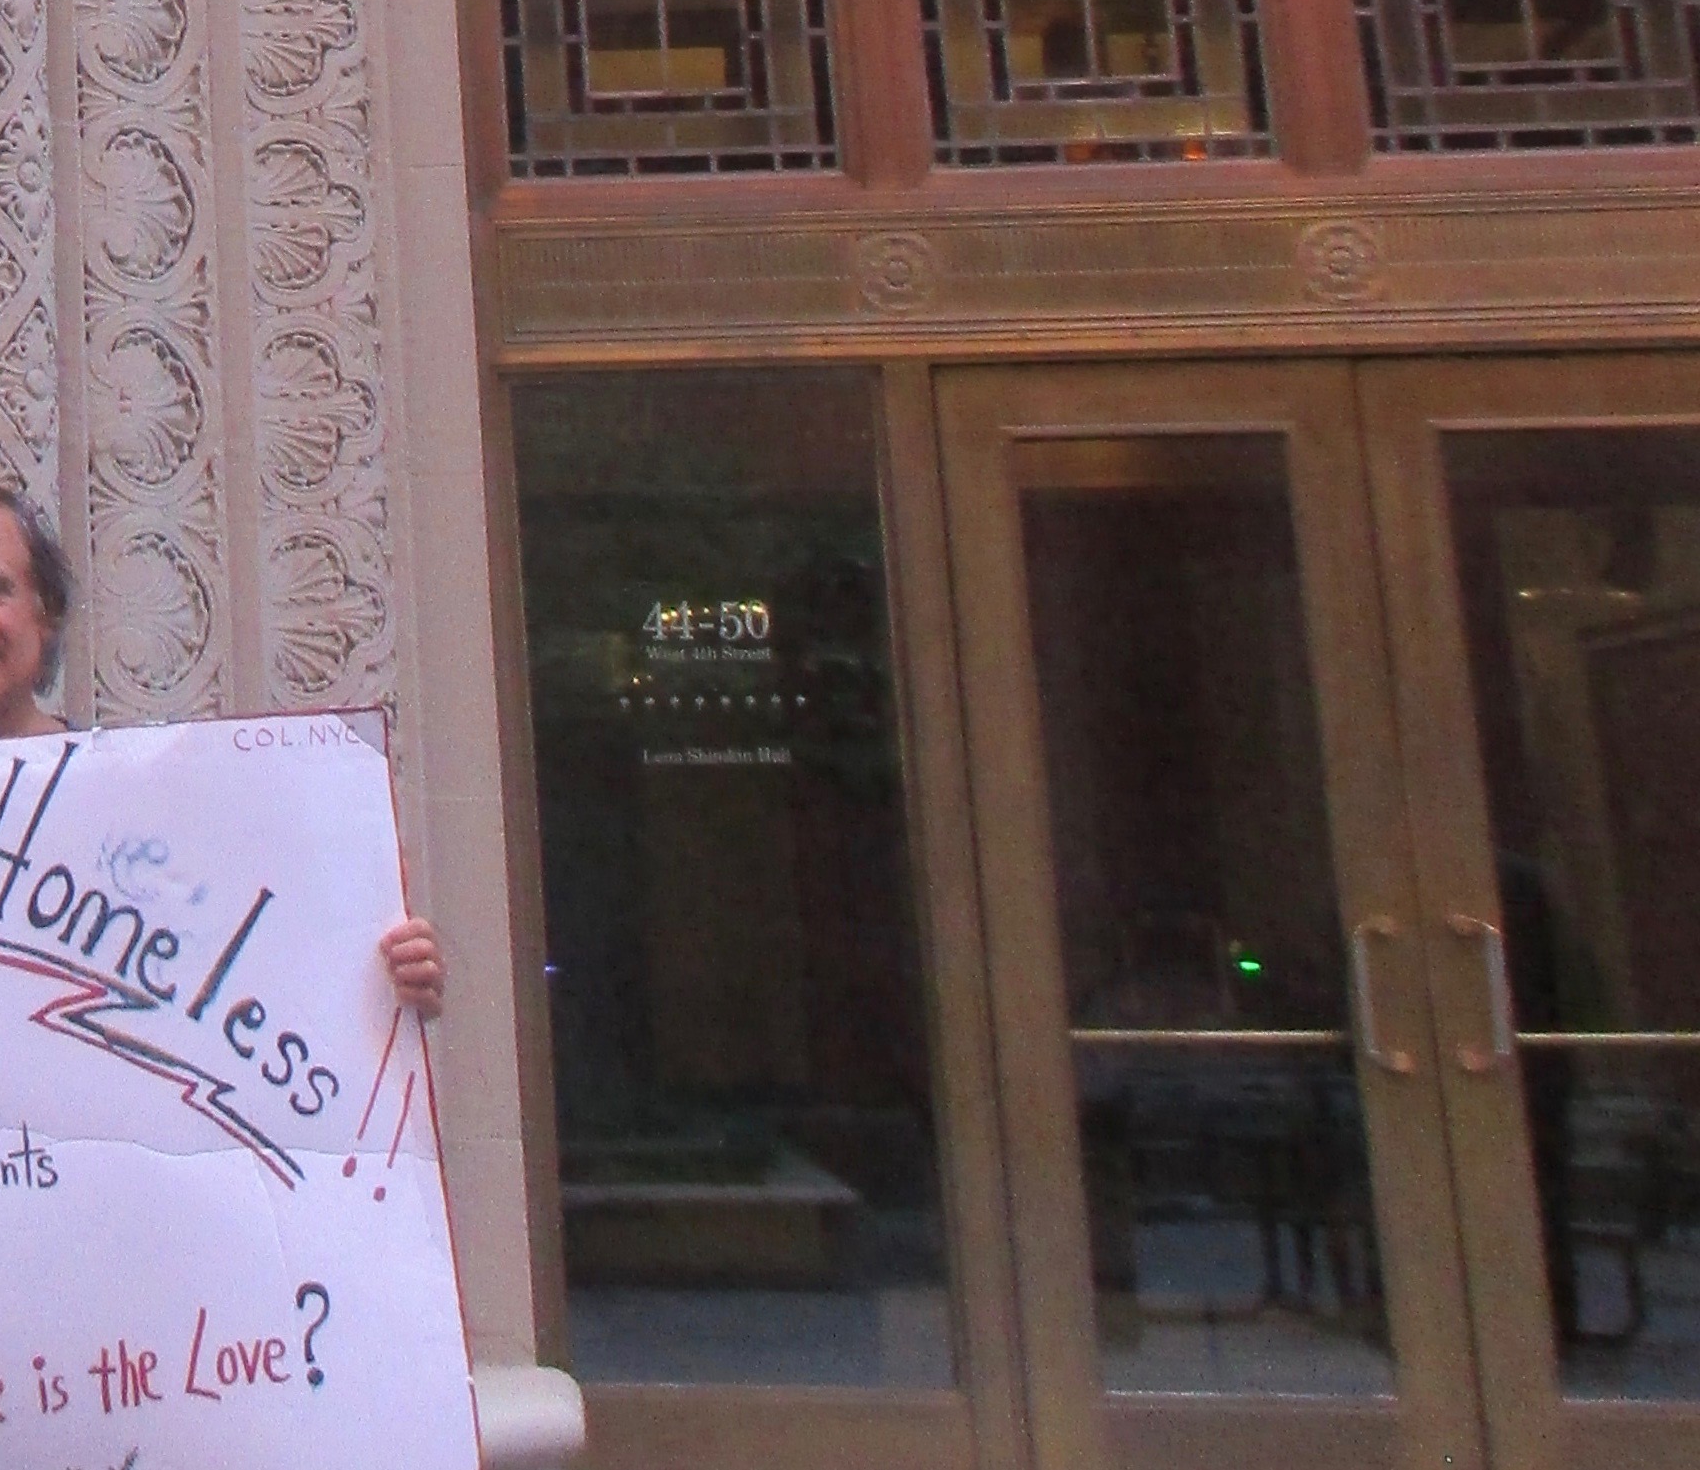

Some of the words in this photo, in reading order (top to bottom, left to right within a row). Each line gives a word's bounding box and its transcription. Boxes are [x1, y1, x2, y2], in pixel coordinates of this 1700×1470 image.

[642, 599, 771, 641] 44-50
[31, 1354, 70, 1414] is
[88, 1339, 164, 1414] the
